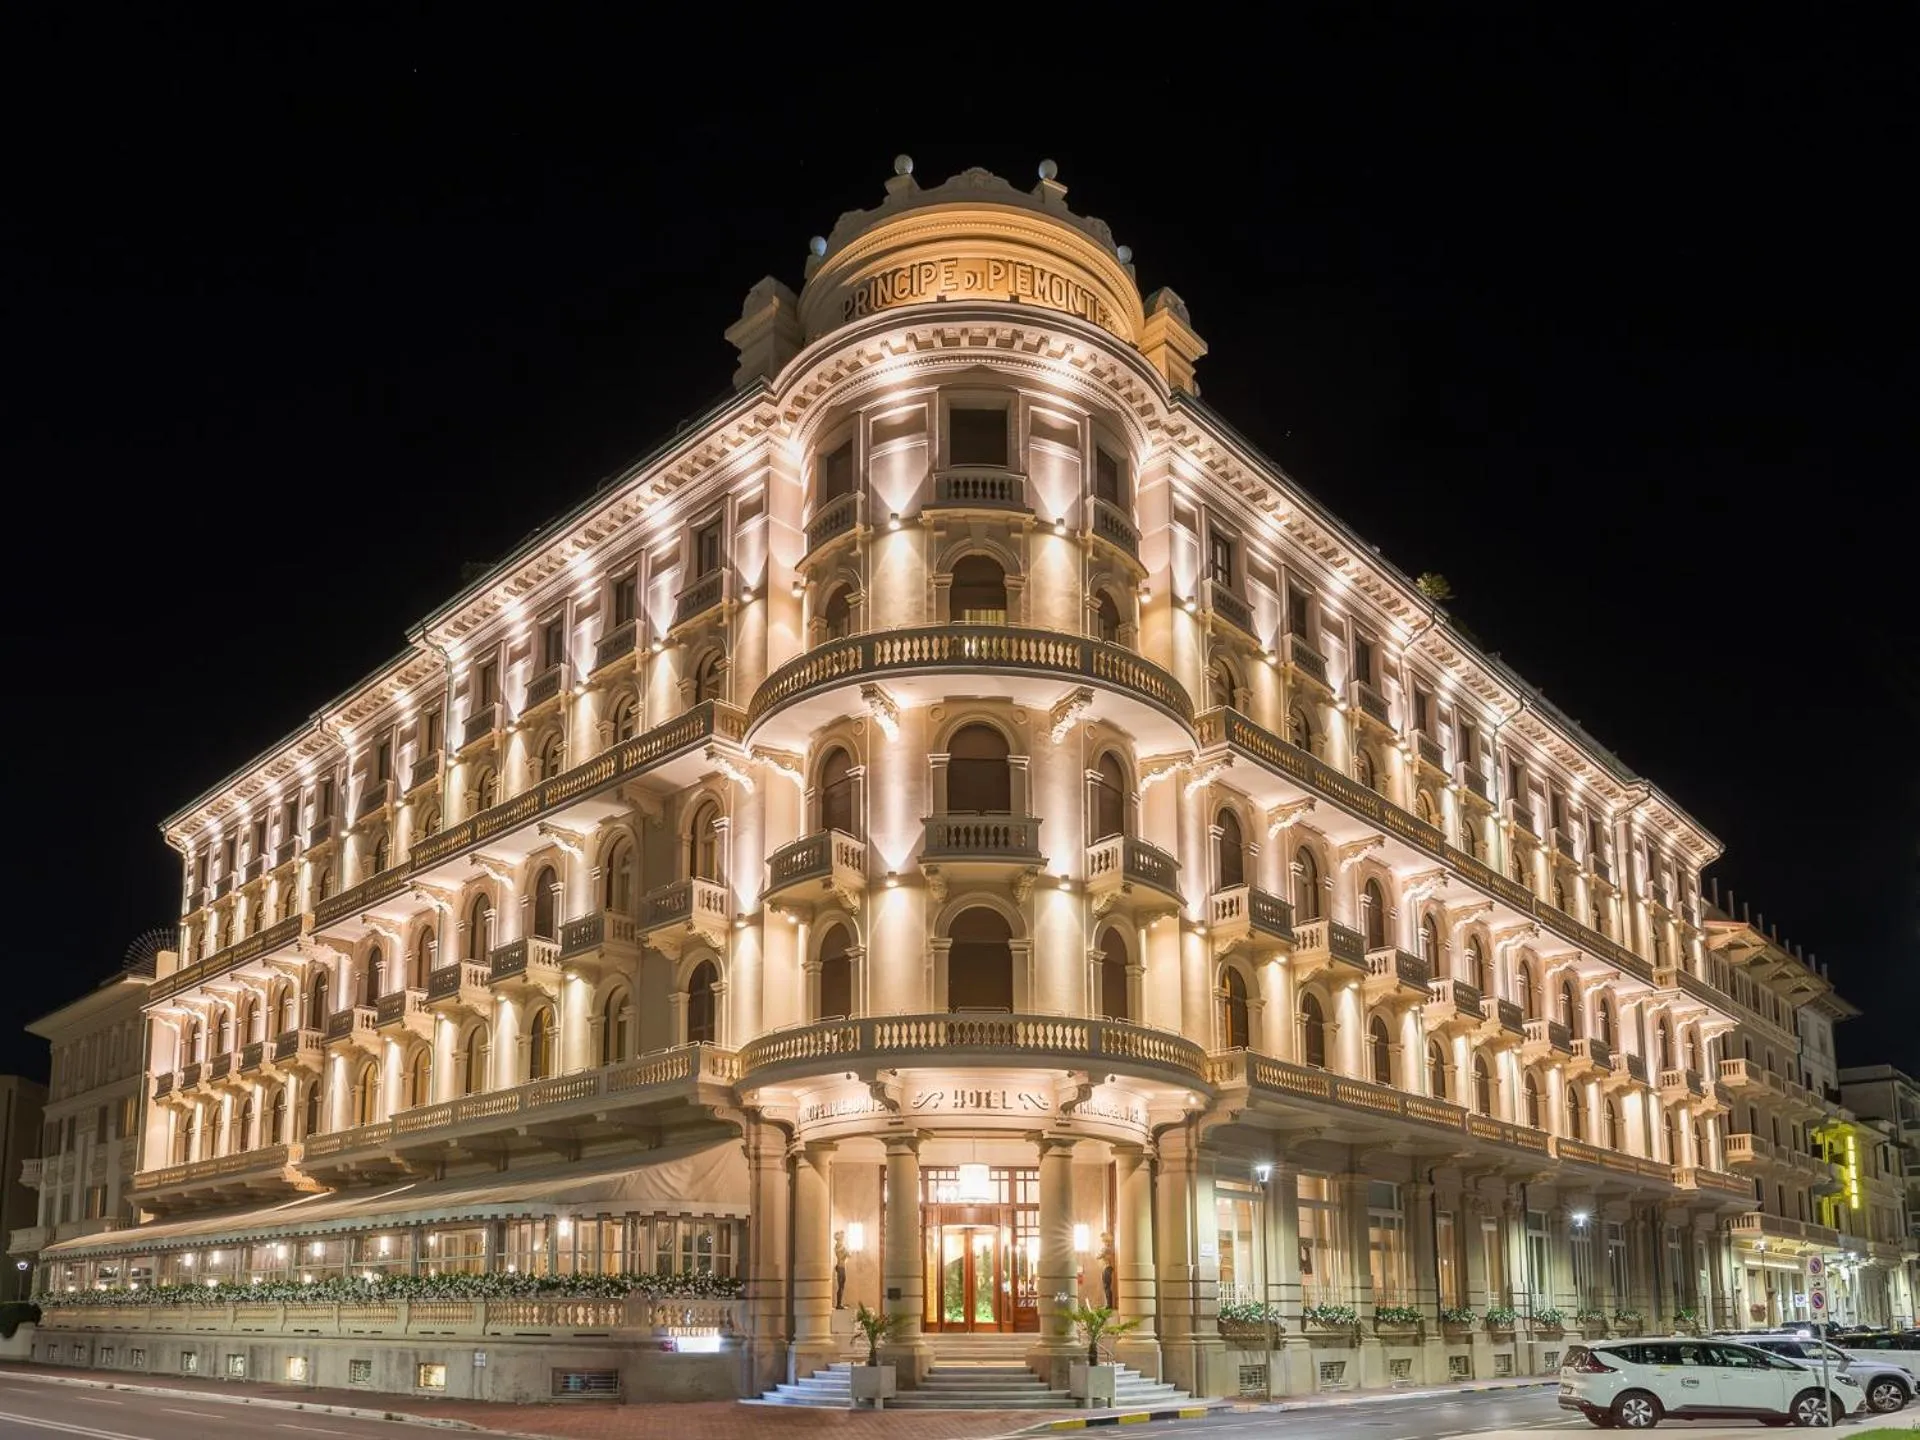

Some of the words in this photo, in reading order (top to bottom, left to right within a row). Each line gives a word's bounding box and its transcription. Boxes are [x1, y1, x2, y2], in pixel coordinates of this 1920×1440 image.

[841, 257, 958, 323] PRINCIPE
[986, 259, 1111, 329] PIEMONTE
[952, 1090, 1014, 1110] HOTEL
